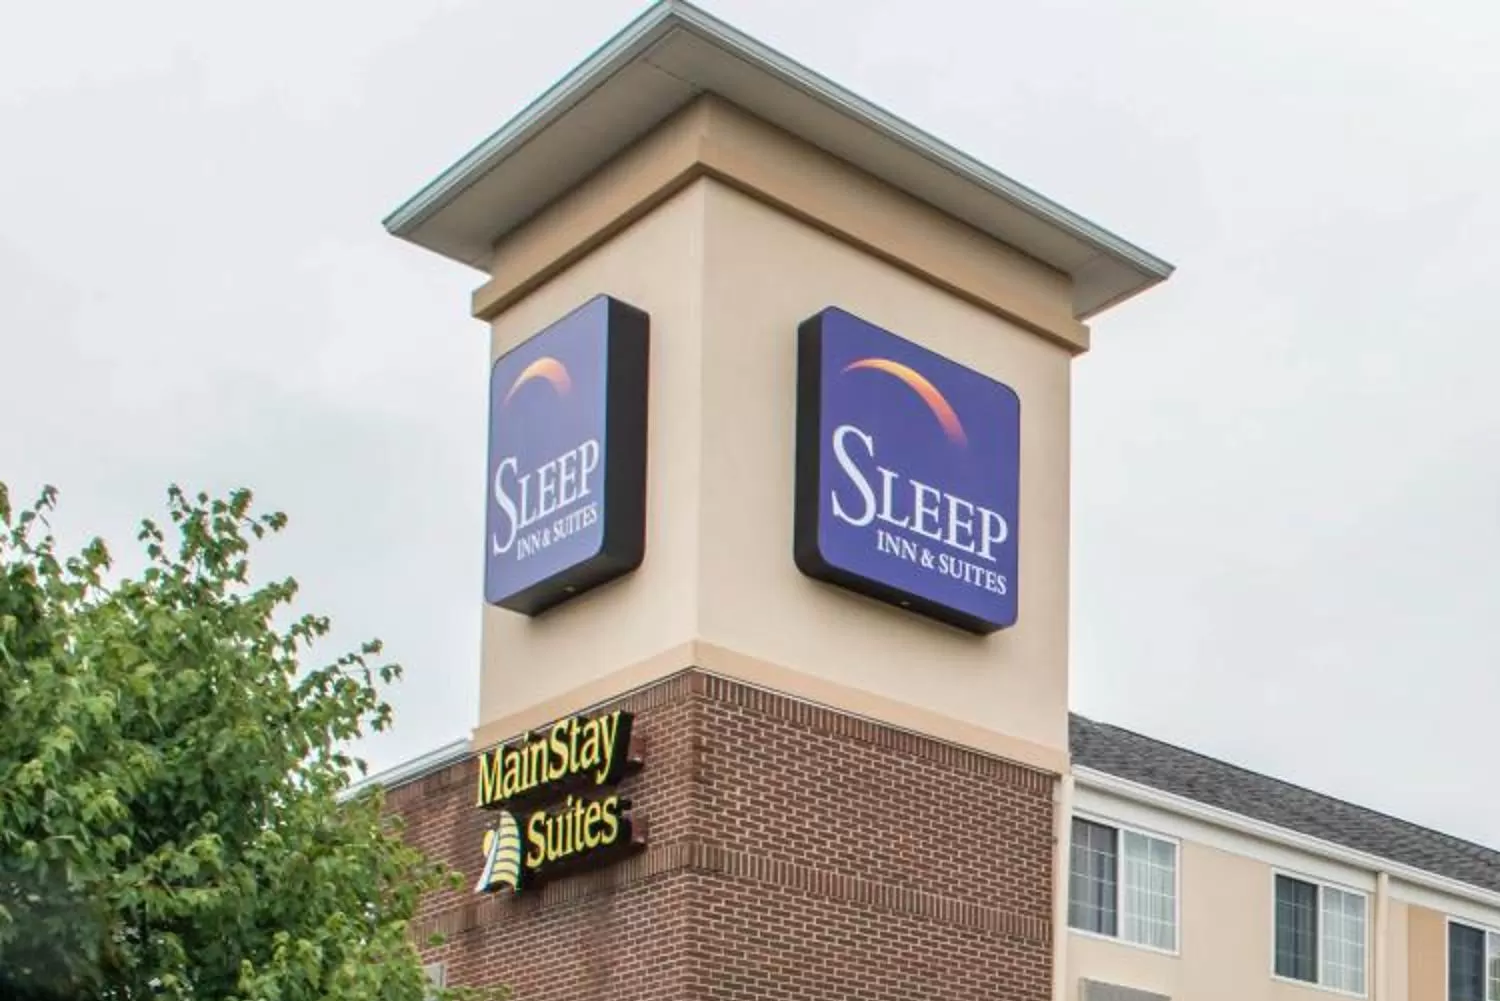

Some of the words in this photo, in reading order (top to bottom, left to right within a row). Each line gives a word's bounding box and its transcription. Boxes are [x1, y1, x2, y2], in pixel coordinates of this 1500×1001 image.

[493, 438, 600, 557] SLEEP
[517, 530, 541, 560] INN
[542, 528, 551, 548] &
[554, 502, 598, 541] SUITES
[832, 424, 1008, 562] SLEEP
[876, 529, 917, 562] INN
[921, 548, 936, 569] &
[939, 553, 1007, 595] SUITES
[475, 710, 621, 807] MainStay
[526, 794, 618, 868] Suites
